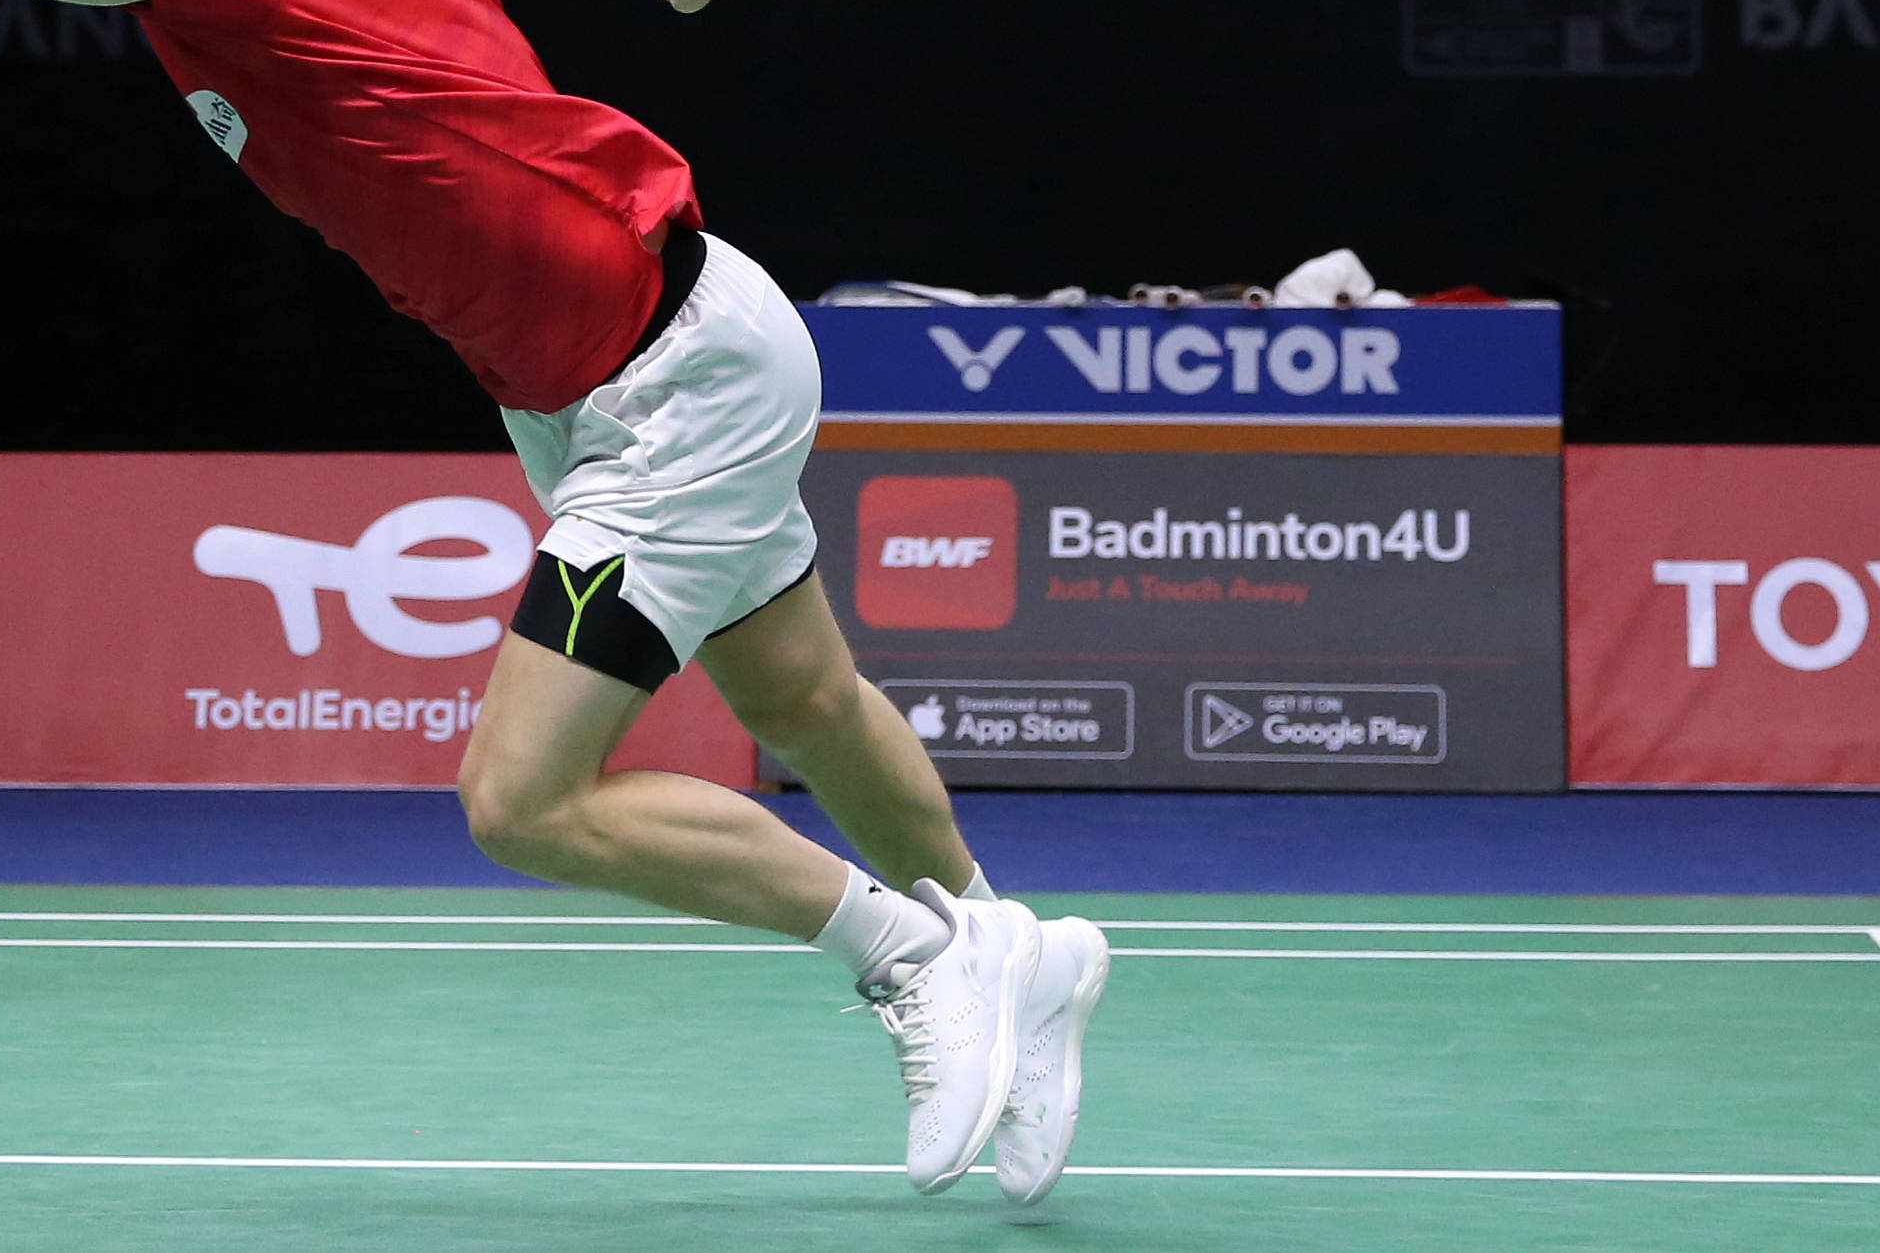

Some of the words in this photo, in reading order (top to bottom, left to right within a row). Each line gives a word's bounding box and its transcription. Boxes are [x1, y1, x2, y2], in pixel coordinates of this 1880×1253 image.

[1045, 325, 1401, 396] VICTOR
[880, 536, 993, 569] BWF
[1049, 506, 1471, 562] Badminton4U
[1046, 575, 1101, 601] Just
[1108, 575, 1131, 600] A
[1139, 575, 1222, 602] Touch
[1228, 577, 1311, 606] Away
[1653, 557, 1880, 671] TO
[185, 688, 483, 742] TotalEnergi
[955, 713, 1017, 746] App
[1021, 713, 1100, 742] Store
[1262, 714, 1366, 752] Google
[1369, 716, 1428, 752] Play
